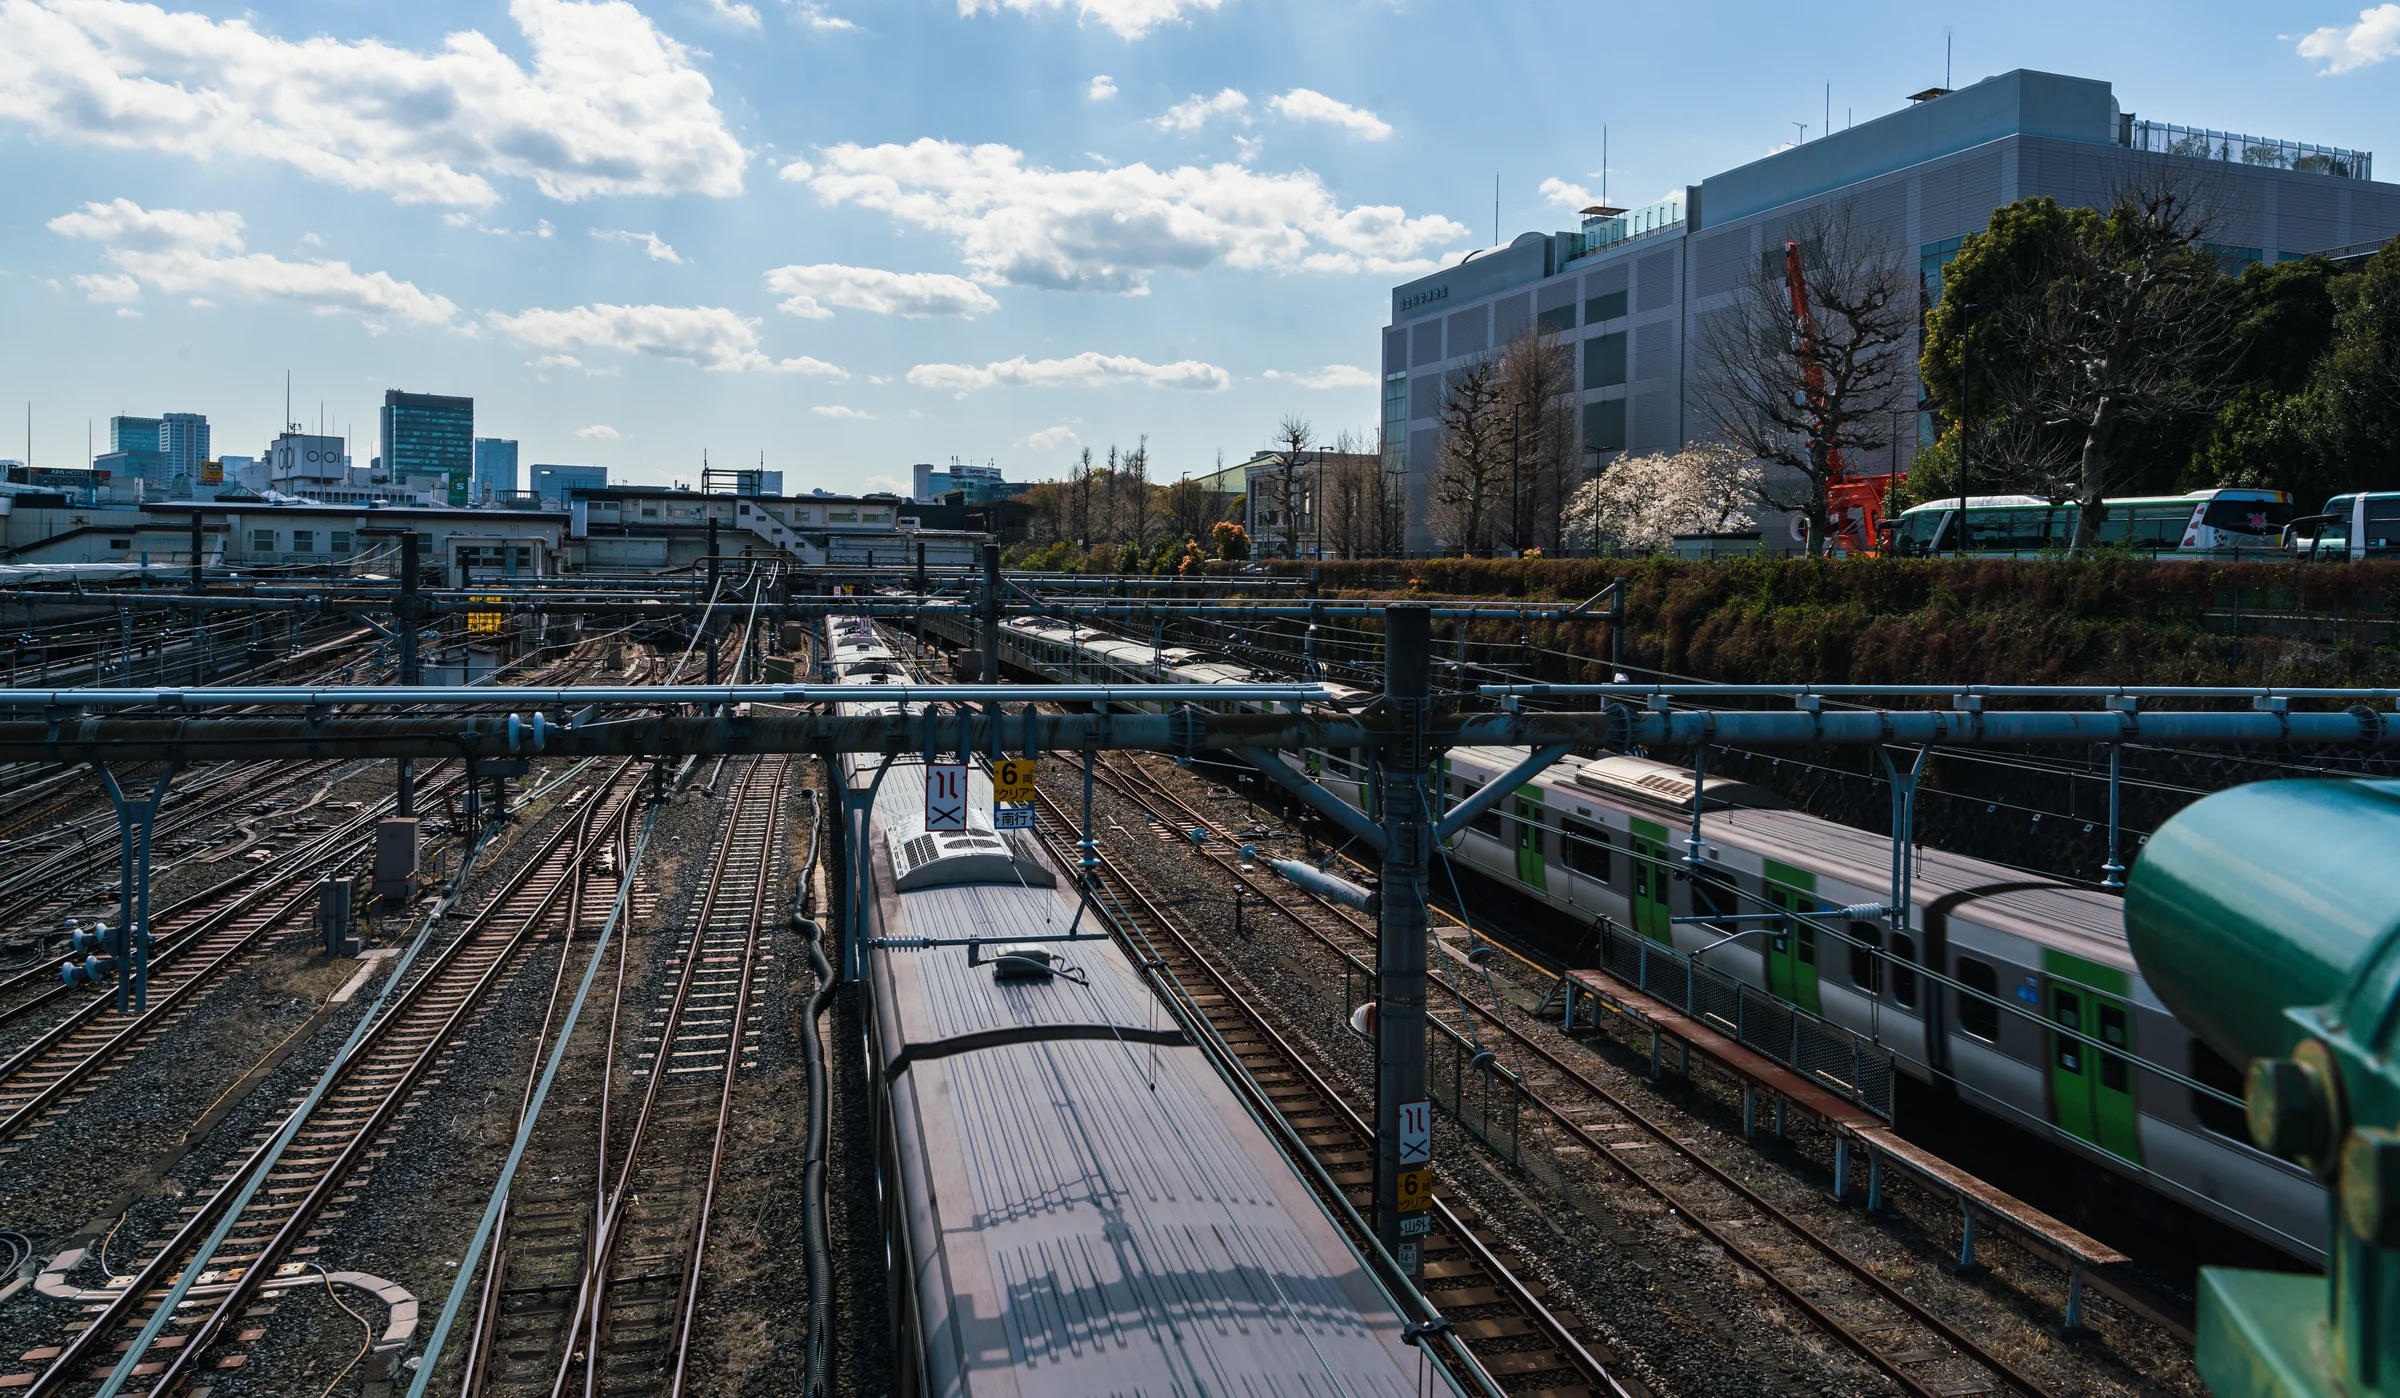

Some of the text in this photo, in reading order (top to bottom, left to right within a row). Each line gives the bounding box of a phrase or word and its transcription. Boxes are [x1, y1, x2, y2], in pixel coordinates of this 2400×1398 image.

[999, 787, 1029, 800] クリア
[1001, 811, 1028, 826] 南行
[1402, 1196, 1428, 1210] クリア
[1404, 1218, 1426, 1234] 山外
[1400, 1252, 1415, 1262] 14-1
